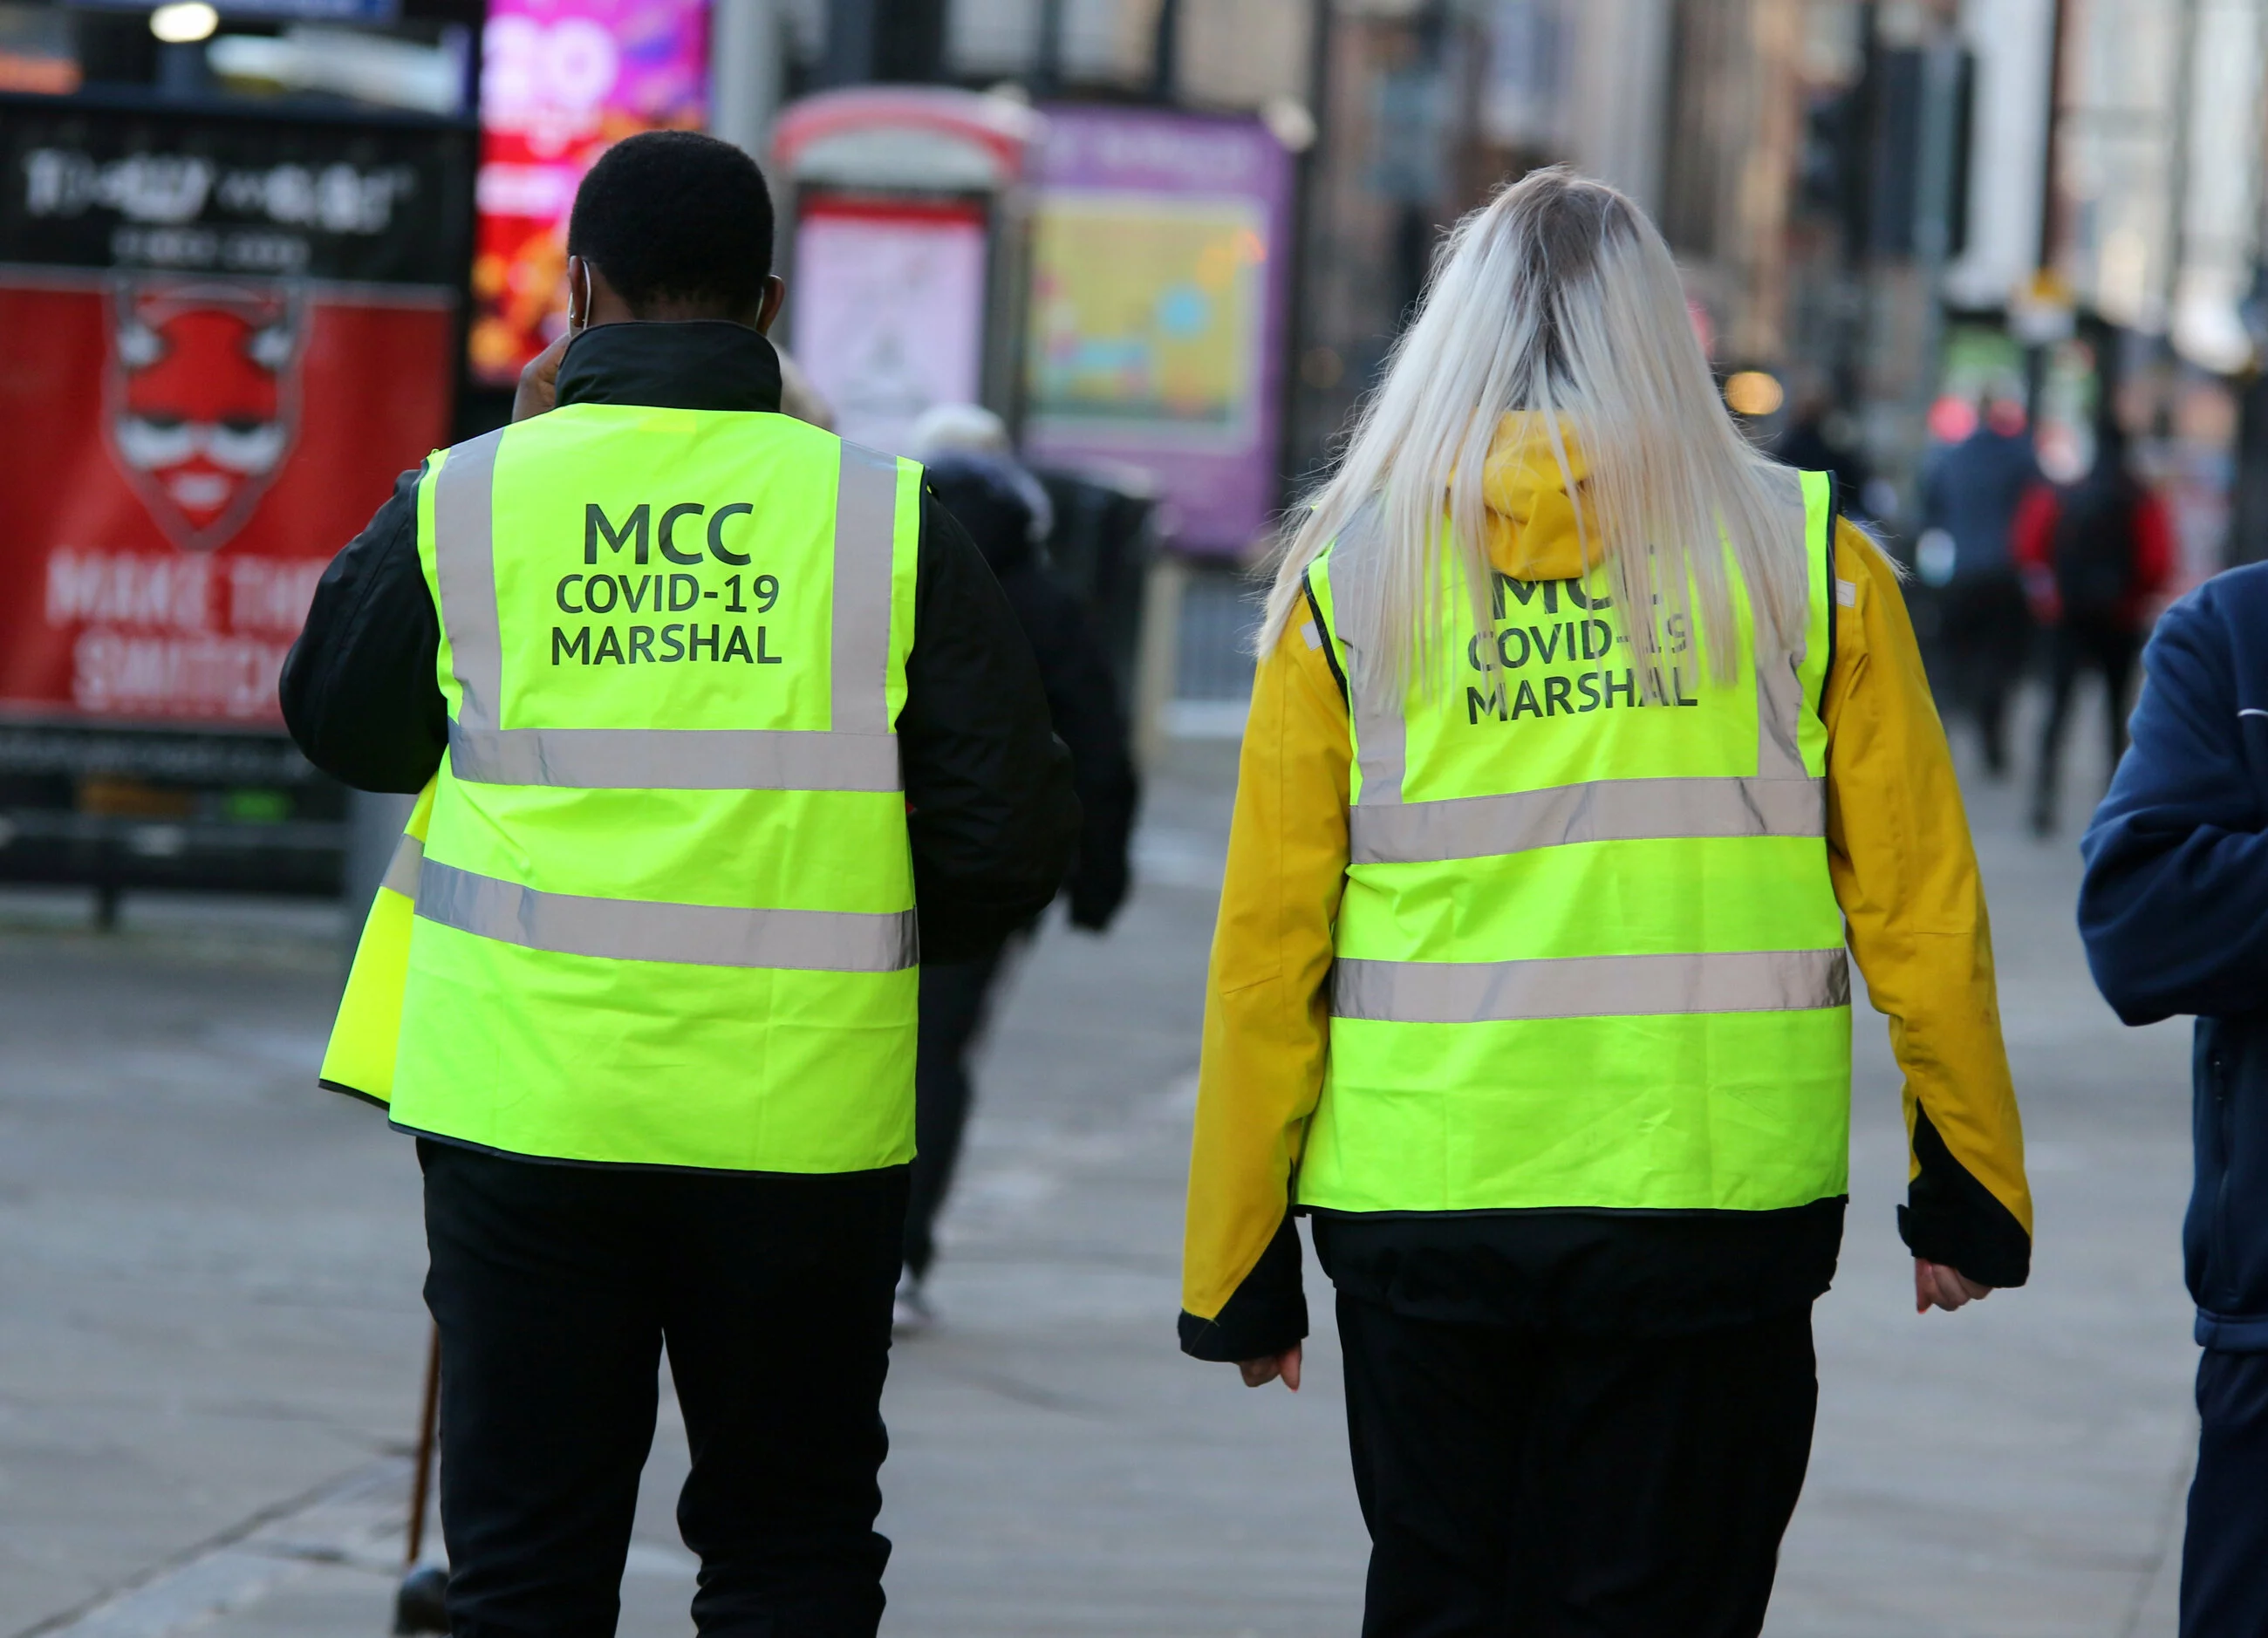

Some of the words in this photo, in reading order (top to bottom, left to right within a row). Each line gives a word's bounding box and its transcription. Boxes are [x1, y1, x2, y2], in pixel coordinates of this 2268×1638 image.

[584, 502, 754, 566] MCC
[556, 574, 780, 613] COVID-19
[551, 624, 782, 665] MARSHAL
